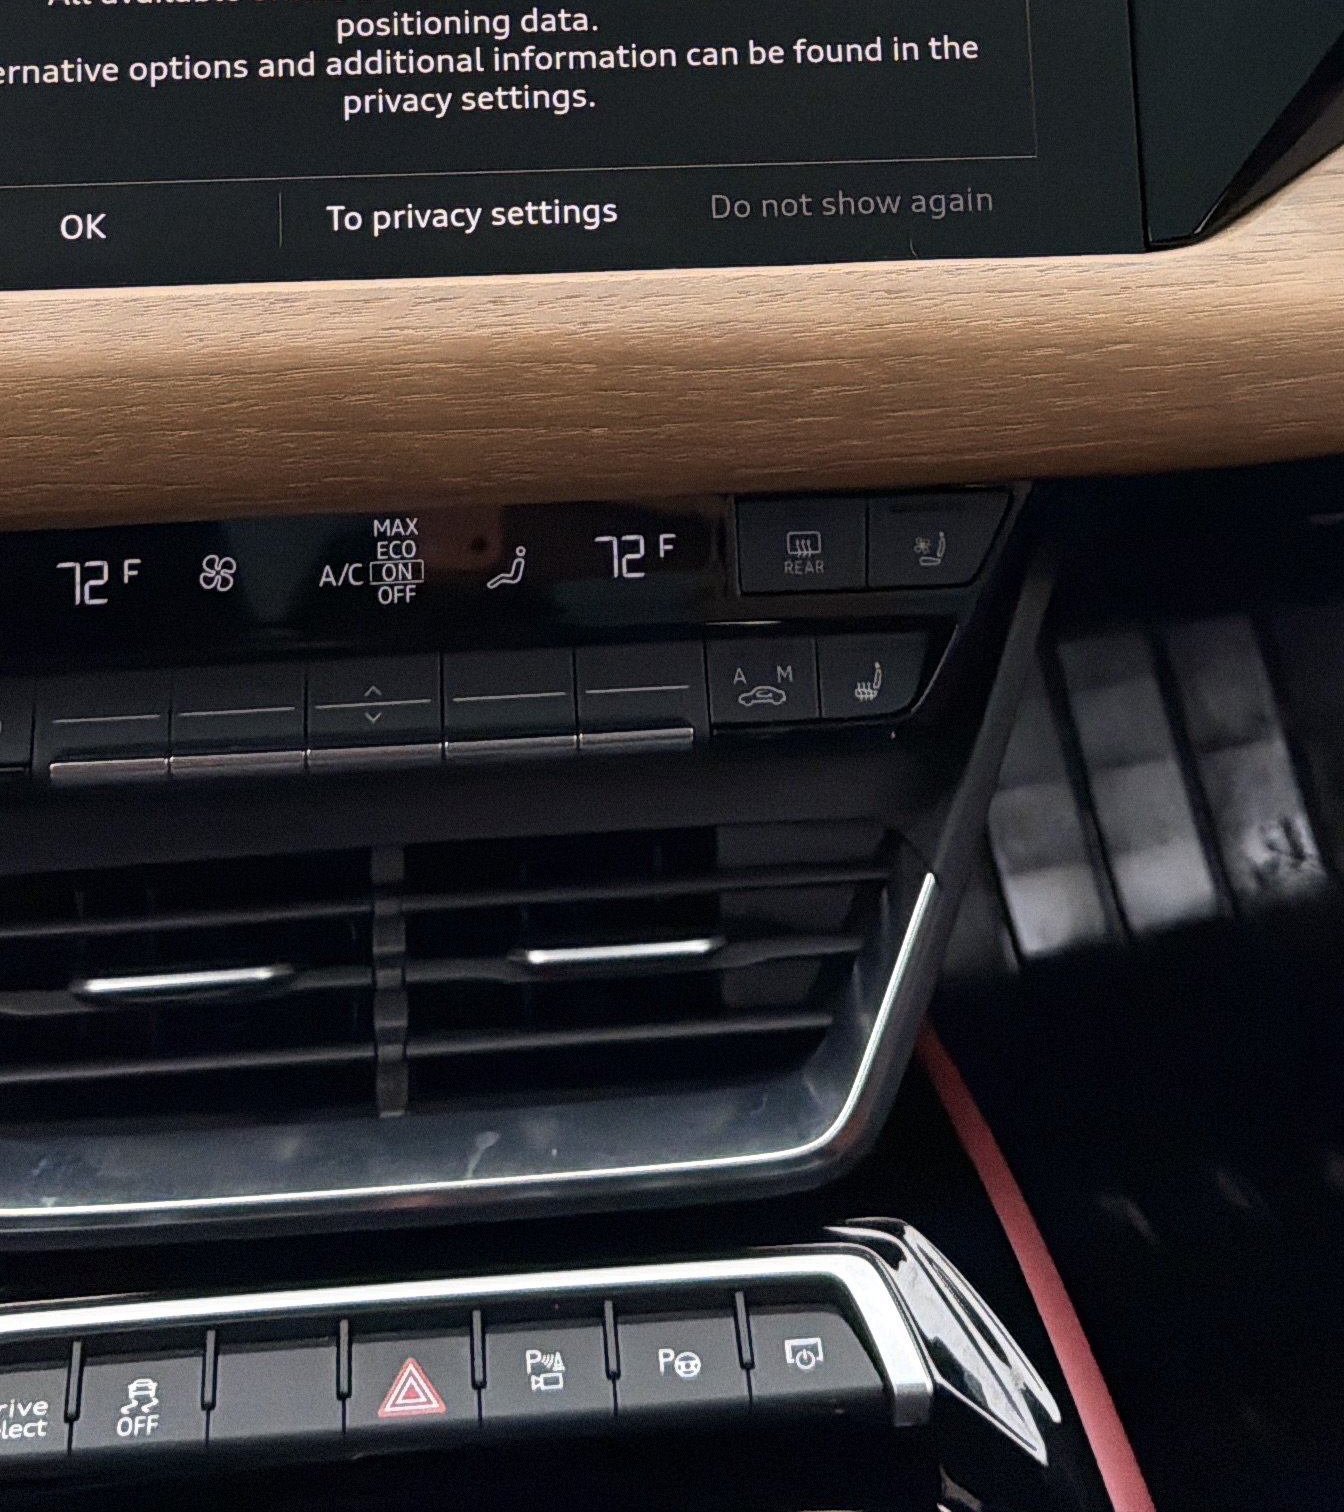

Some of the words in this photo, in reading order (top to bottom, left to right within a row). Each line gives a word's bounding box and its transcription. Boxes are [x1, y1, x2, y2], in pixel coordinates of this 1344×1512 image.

[337, 10, 509, 44] positioning
[521, 7, 597, 32] data.
[130, 55, 248, 87] options
[259, 51, 314, 77] and
[326, 47, 484, 75] additional
[494, 44, 676, 71] information
[687, 47, 738, 66] can
[749, 40, 784, 64] be
[793, 37, 882, 63] found
[894, 37, 918, 61] in
[928, 35, 978, 59] the
[344, 88, 452, 121] privacy
[462, 85, 595, 115] settings.
[712, 195, 750, 218] Do
[762, 194, 812, 217] not
[822, 190, 901, 215] show
[911, 188, 992, 219] again
[61, 214, 106, 239] OK
[326, 206, 362, 231] To
[374, 204, 482, 237] privacy
[492, 199, 617, 230] settings
[374, 518, 418, 536] MAX
[377, 540, 416, 559] ECO
[595, 535, 645, 578] 72
[659, 534, 676, 557] F
[319, 564, 364, 587] A/C
[382, 563, 412, 580] ON
[784, 560, 824, 575] REAR
[57, 561, 108, 605] 72
[124, 559, 141, 583] F
[378, 585, 416, 605] OFF
[117, 1415, 159, 1436] OFF
